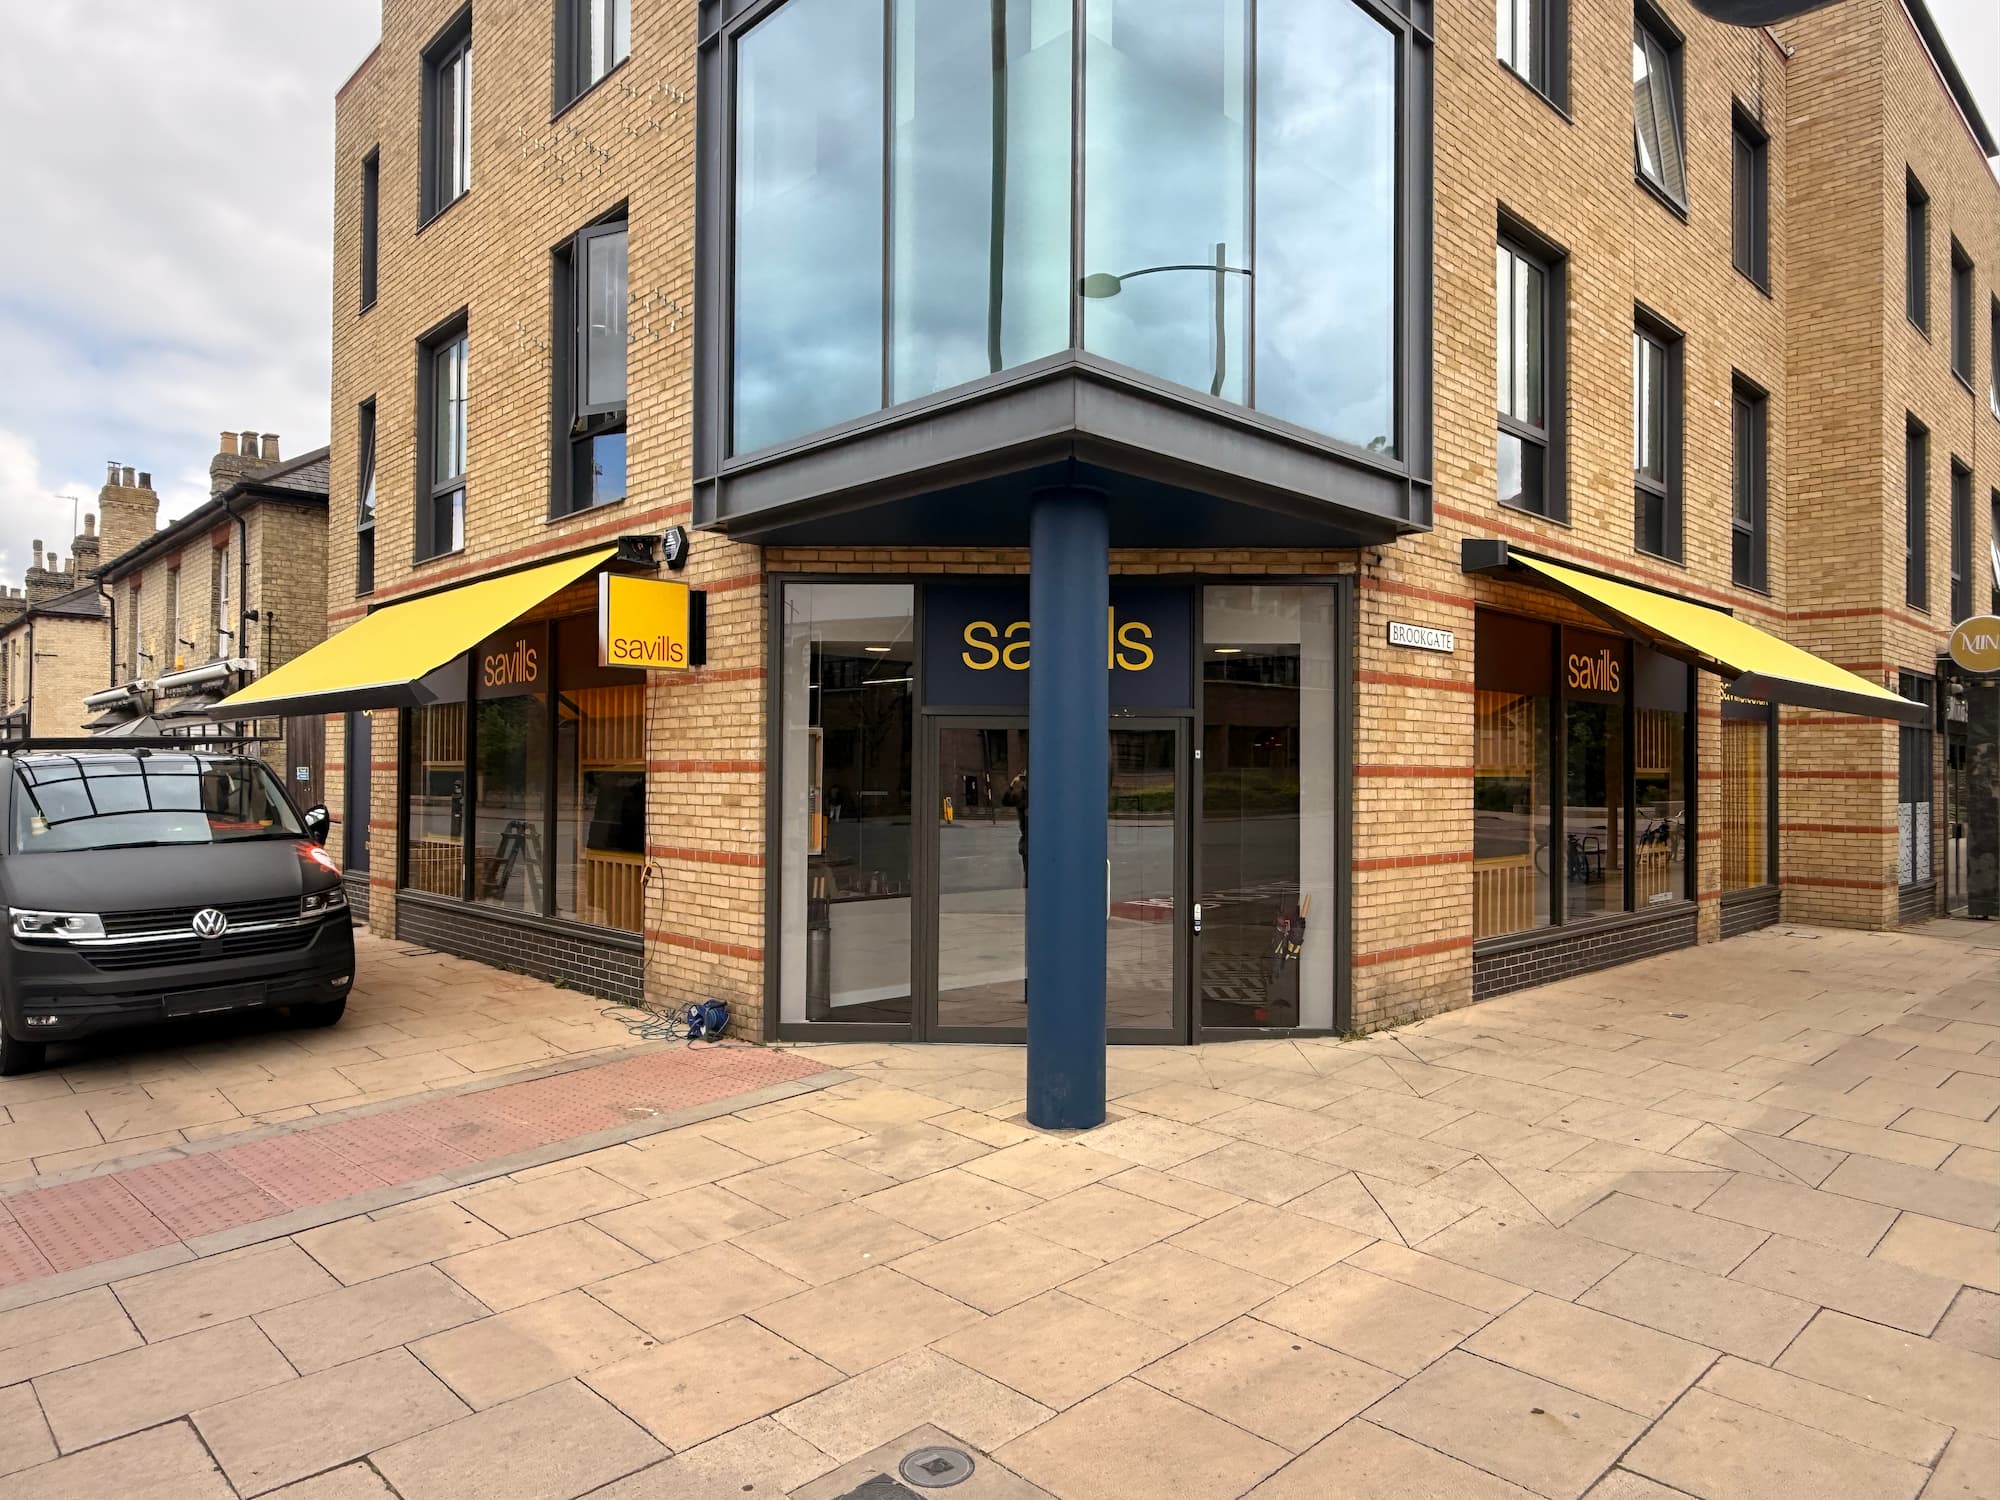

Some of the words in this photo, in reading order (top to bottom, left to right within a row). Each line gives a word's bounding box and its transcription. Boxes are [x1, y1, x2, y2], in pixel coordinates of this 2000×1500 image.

[614, 635, 683, 662] savills
[962, 606, 1154, 671] sals
[1393, 625, 1452, 649] BROOKGATE
[484, 639, 537, 687] savills
[1568, 649, 1620, 693] savills
